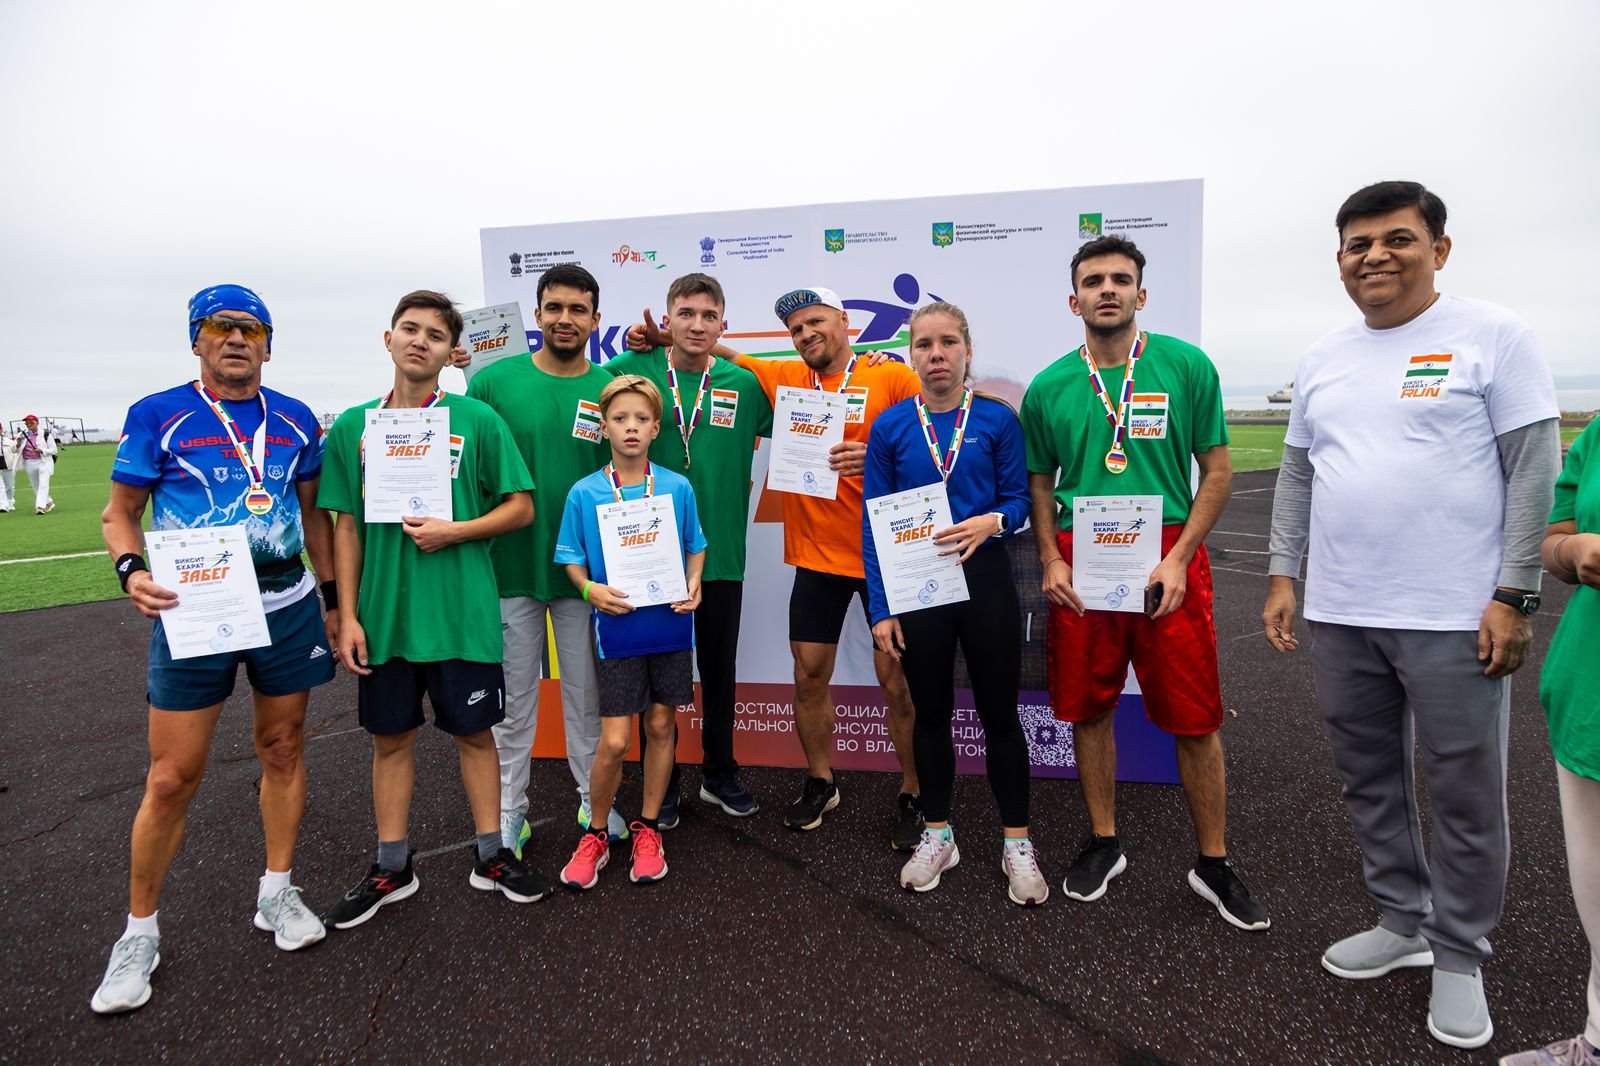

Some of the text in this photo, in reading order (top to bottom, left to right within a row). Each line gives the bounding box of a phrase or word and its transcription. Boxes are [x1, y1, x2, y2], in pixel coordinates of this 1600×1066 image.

[473, 336, 509, 353] ЗАБЕГ
[1400, 387, 1441, 399] RUN
[712, 416, 732, 426] RUN
[845, 413, 860, 421] UN
[575, 428, 599, 440] RUN
[789, 422, 828, 436] ЗАБЕГ
[1131, 428, 1162, 436] RUN
[386, 445, 431, 456] ЗАБЕГ
[617, 523, 640, 531] ВИКСИТ
[890, 517, 914, 527] ВИКСИТ
[891, 523, 914, 533] БХАРАТ
[620, 531, 660, 547] ЗАБЕГ
[894, 524, 935, 545] ЗАБЕГ
[1093, 532, 1141, 544] ЗАБЕГ
[175, 556, 204, 565] ВИКСИТ
[179, 566, 231, 584] ЗАБЕГ
[837, 739, 858, 752] ВО
